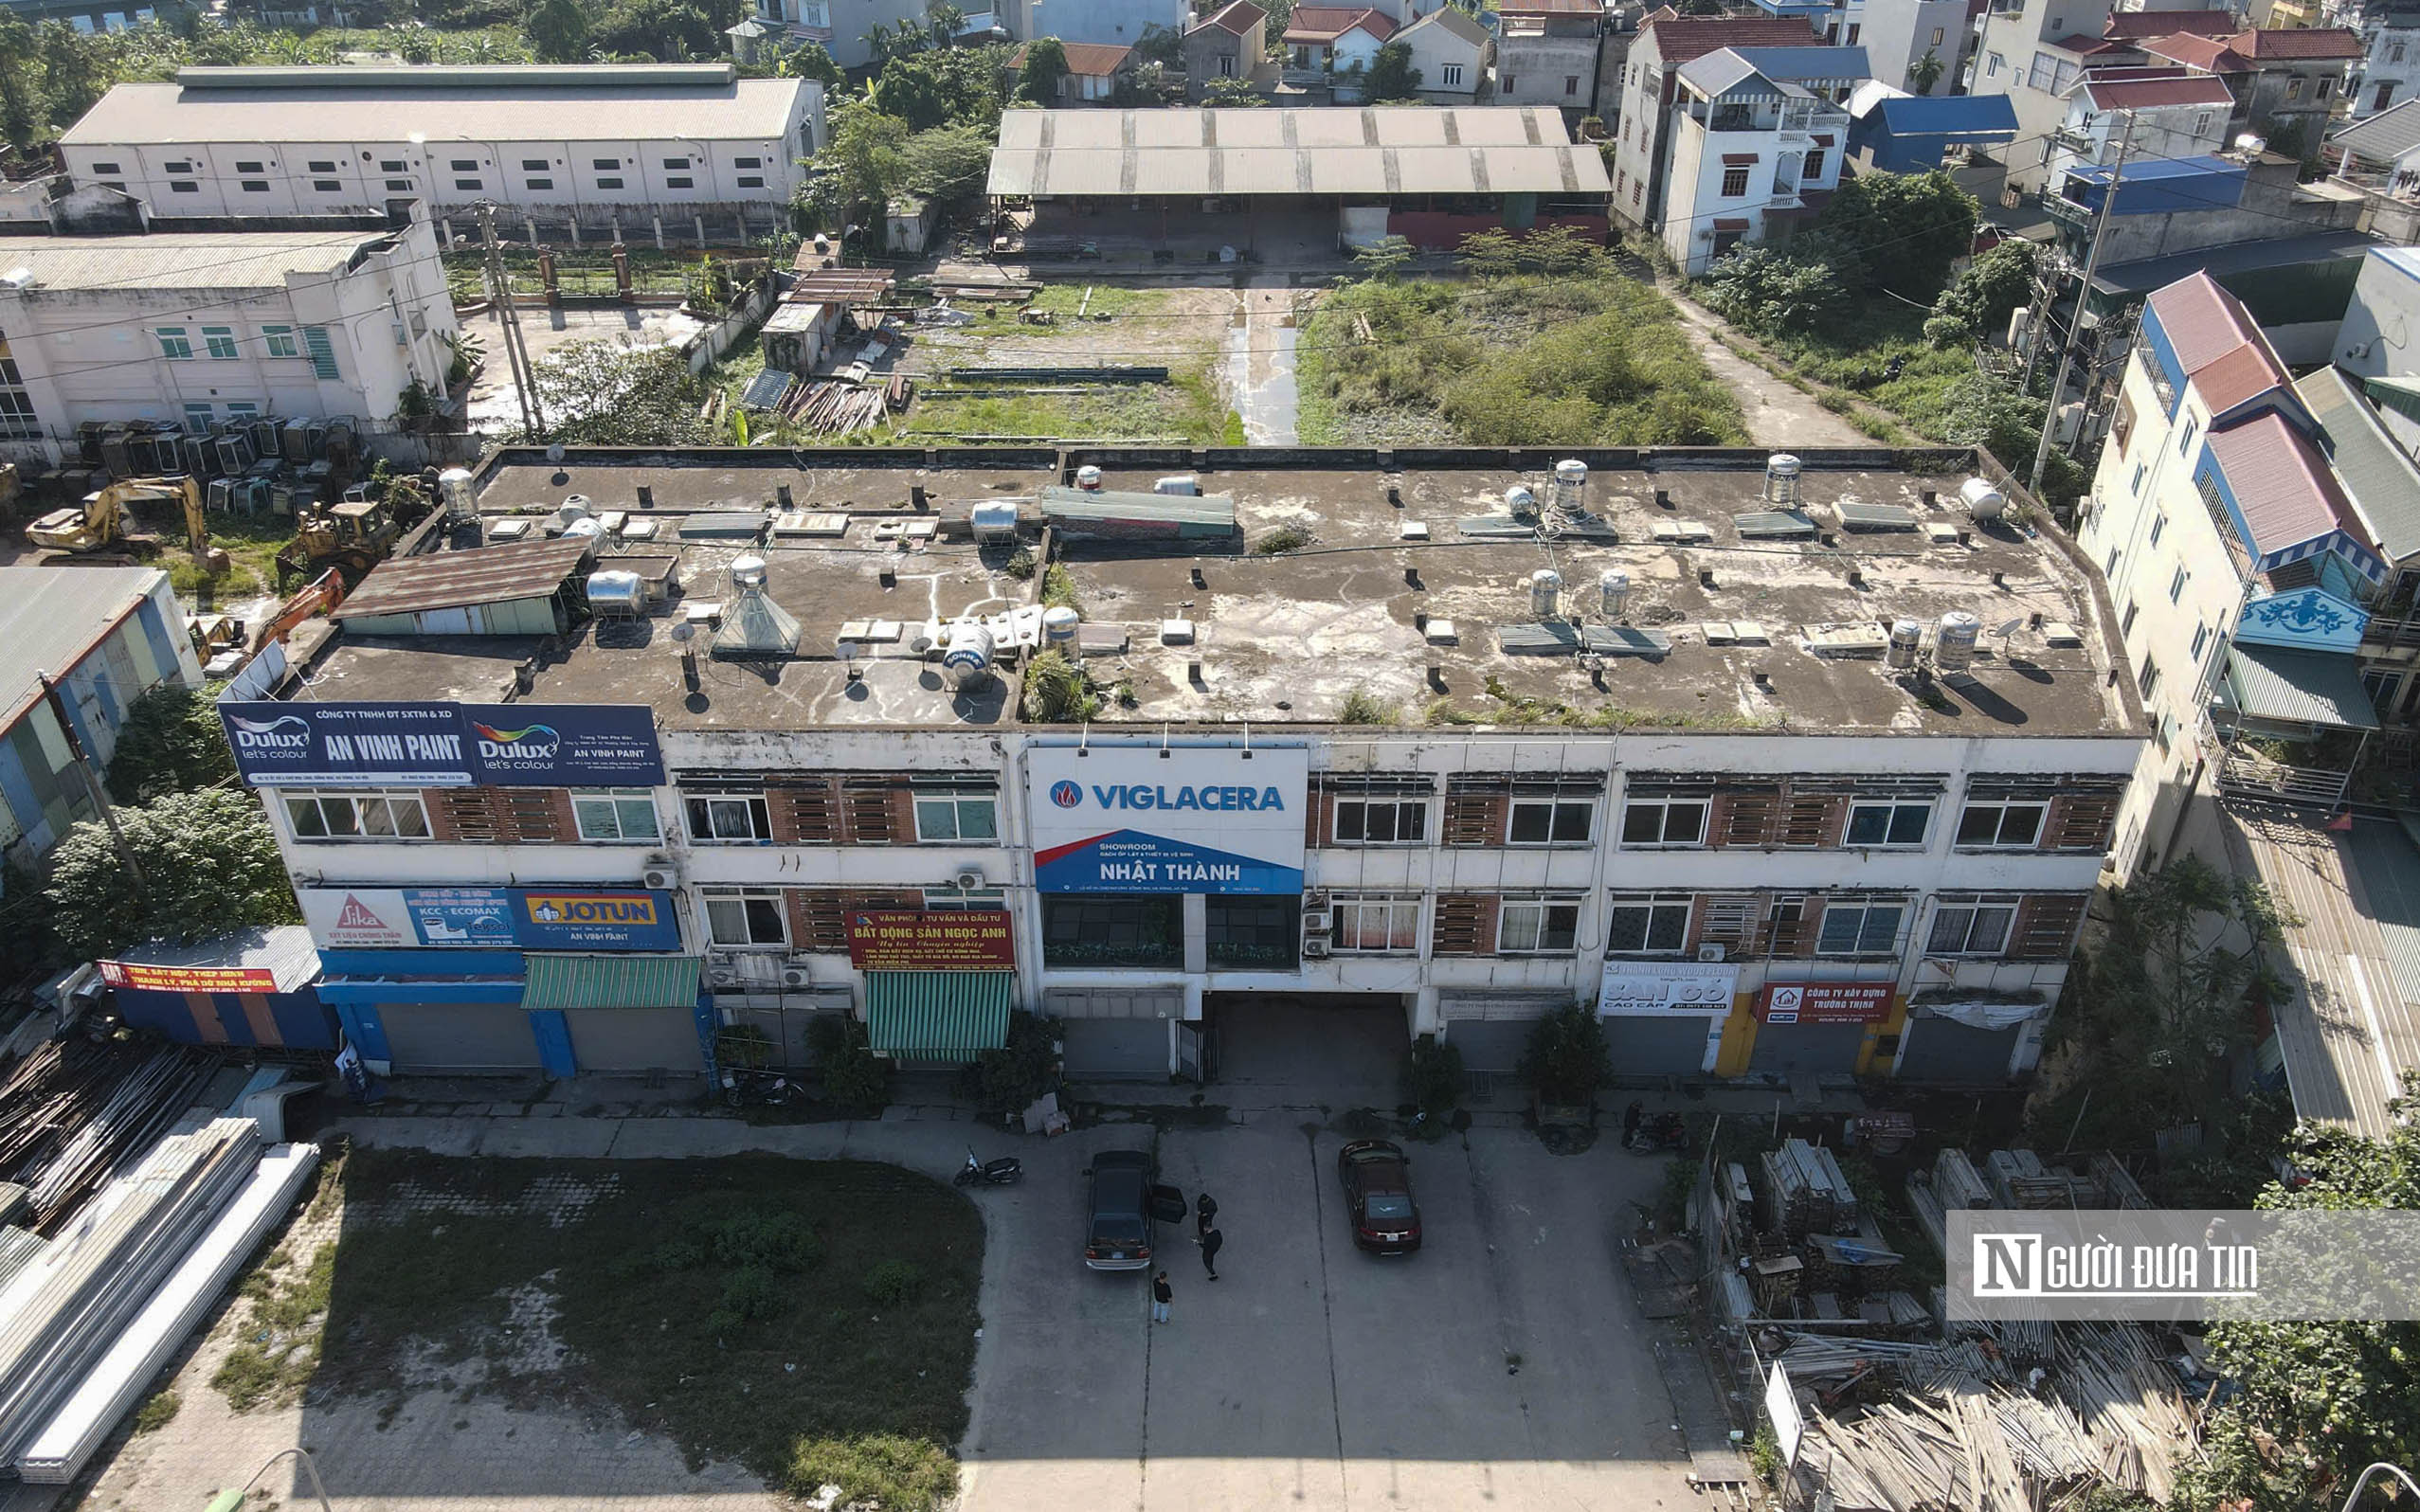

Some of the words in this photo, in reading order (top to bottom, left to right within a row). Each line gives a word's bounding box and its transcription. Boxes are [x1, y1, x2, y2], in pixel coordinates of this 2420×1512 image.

[316, 709, 344, 719] CÔNG
[346, 711, 358, 719] TY
[359, 711, 386, 719] TNHH
[401, 711, 428, 719] SXTM
[429, 711, 437, 719] &
[438, 711, 452, 719] XD
[236, 729, 305, 747] Dulux
[243, 749, 267, 759] let's
[269, 749, 308, 759] colour
[325, 734, 355, 761] AN
[354, 734, 404, 761] VINH
[405, 734, 462, 761] PAINT
[478, 740, 553, 760] Dulux
[574, 749, 588, 758] AN
[591, 749, 615, 758] VINH
[617, 749, 645, 758] PAINT
[484, 760, 511, 770] let's
[514, 760, 554, 770] colour
[1092, 784, 1285, 812] VIGLACERA
[1100, 859, 1157, 883] NHẬT
[1165, 860, 1240, 881] THÀNH
[343, 905, 378, 926] Sika
[419, 908, 442, 916] KCC
[451, 908, 501, 916] ECOMAX
[563, 902, 652, 921] JOTUN
[939, 913, 956, 922] VẤN
[958, 913, 969, 922] VÀ
[970, 913, 988, 922] ĐẦU
[855, 925, 877, 938] BẤT
[880, 926, 913, 941] ĐỘNG
[917, 925, 942, 938] SẢN
[945, 927, 978, 941] NGỌC
[981, 927, 1006, 938] ANH
[1604, 980, 1670, 1002] SÀN
[1807, 987, 1830, 998] CÔNG
[1833, 989, 1843, 998] TY
[1844, 987, 1861, 998] XÂY
[1862, 989, 1887, 999] DỰNG
[1814, 999, 1847, 1009] TRƯỜNG
[1850, 1000, 1875, 1011] THỊNH
